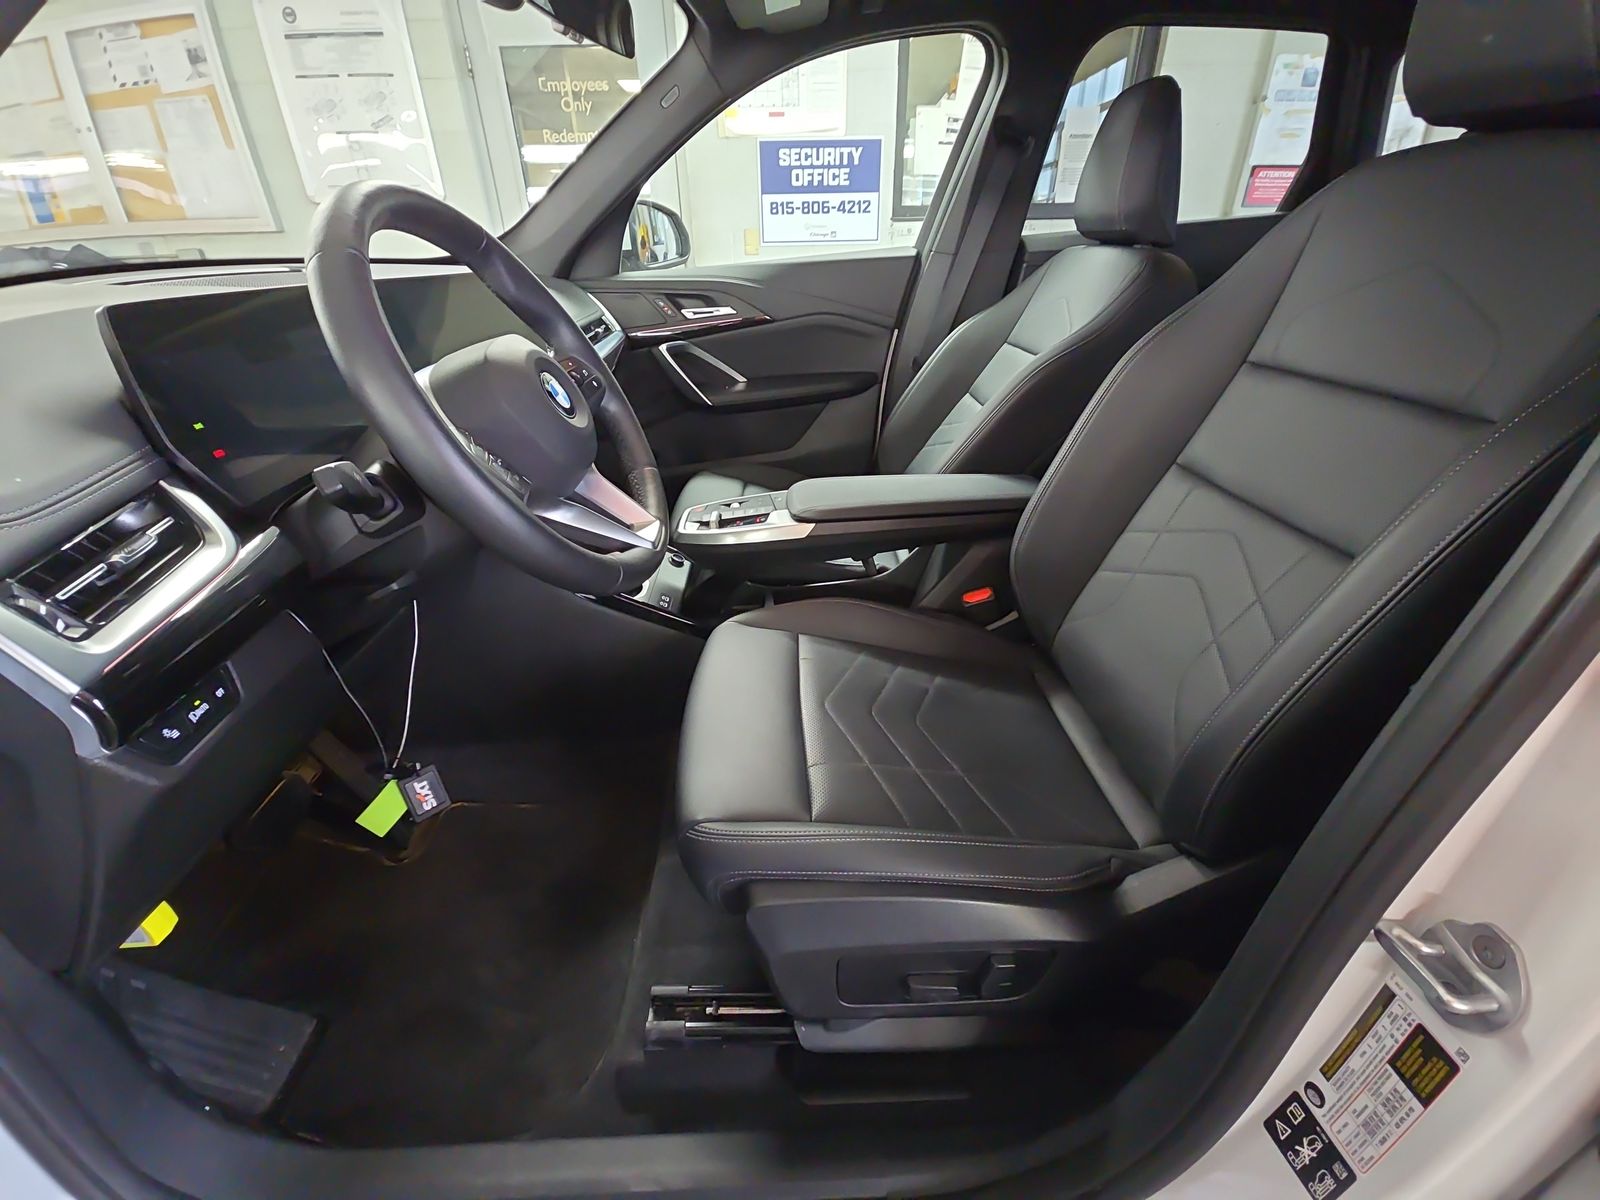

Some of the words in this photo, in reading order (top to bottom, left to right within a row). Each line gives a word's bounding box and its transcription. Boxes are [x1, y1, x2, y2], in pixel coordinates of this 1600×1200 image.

[538, 76, 609, 96] Employees
[560, 96, 592, 116] Only
[778, 146, 864, 166] SECURITY
[791, 167, 850, 187] OFFICE
[770, 200, 871, 215] 815-806-4212
